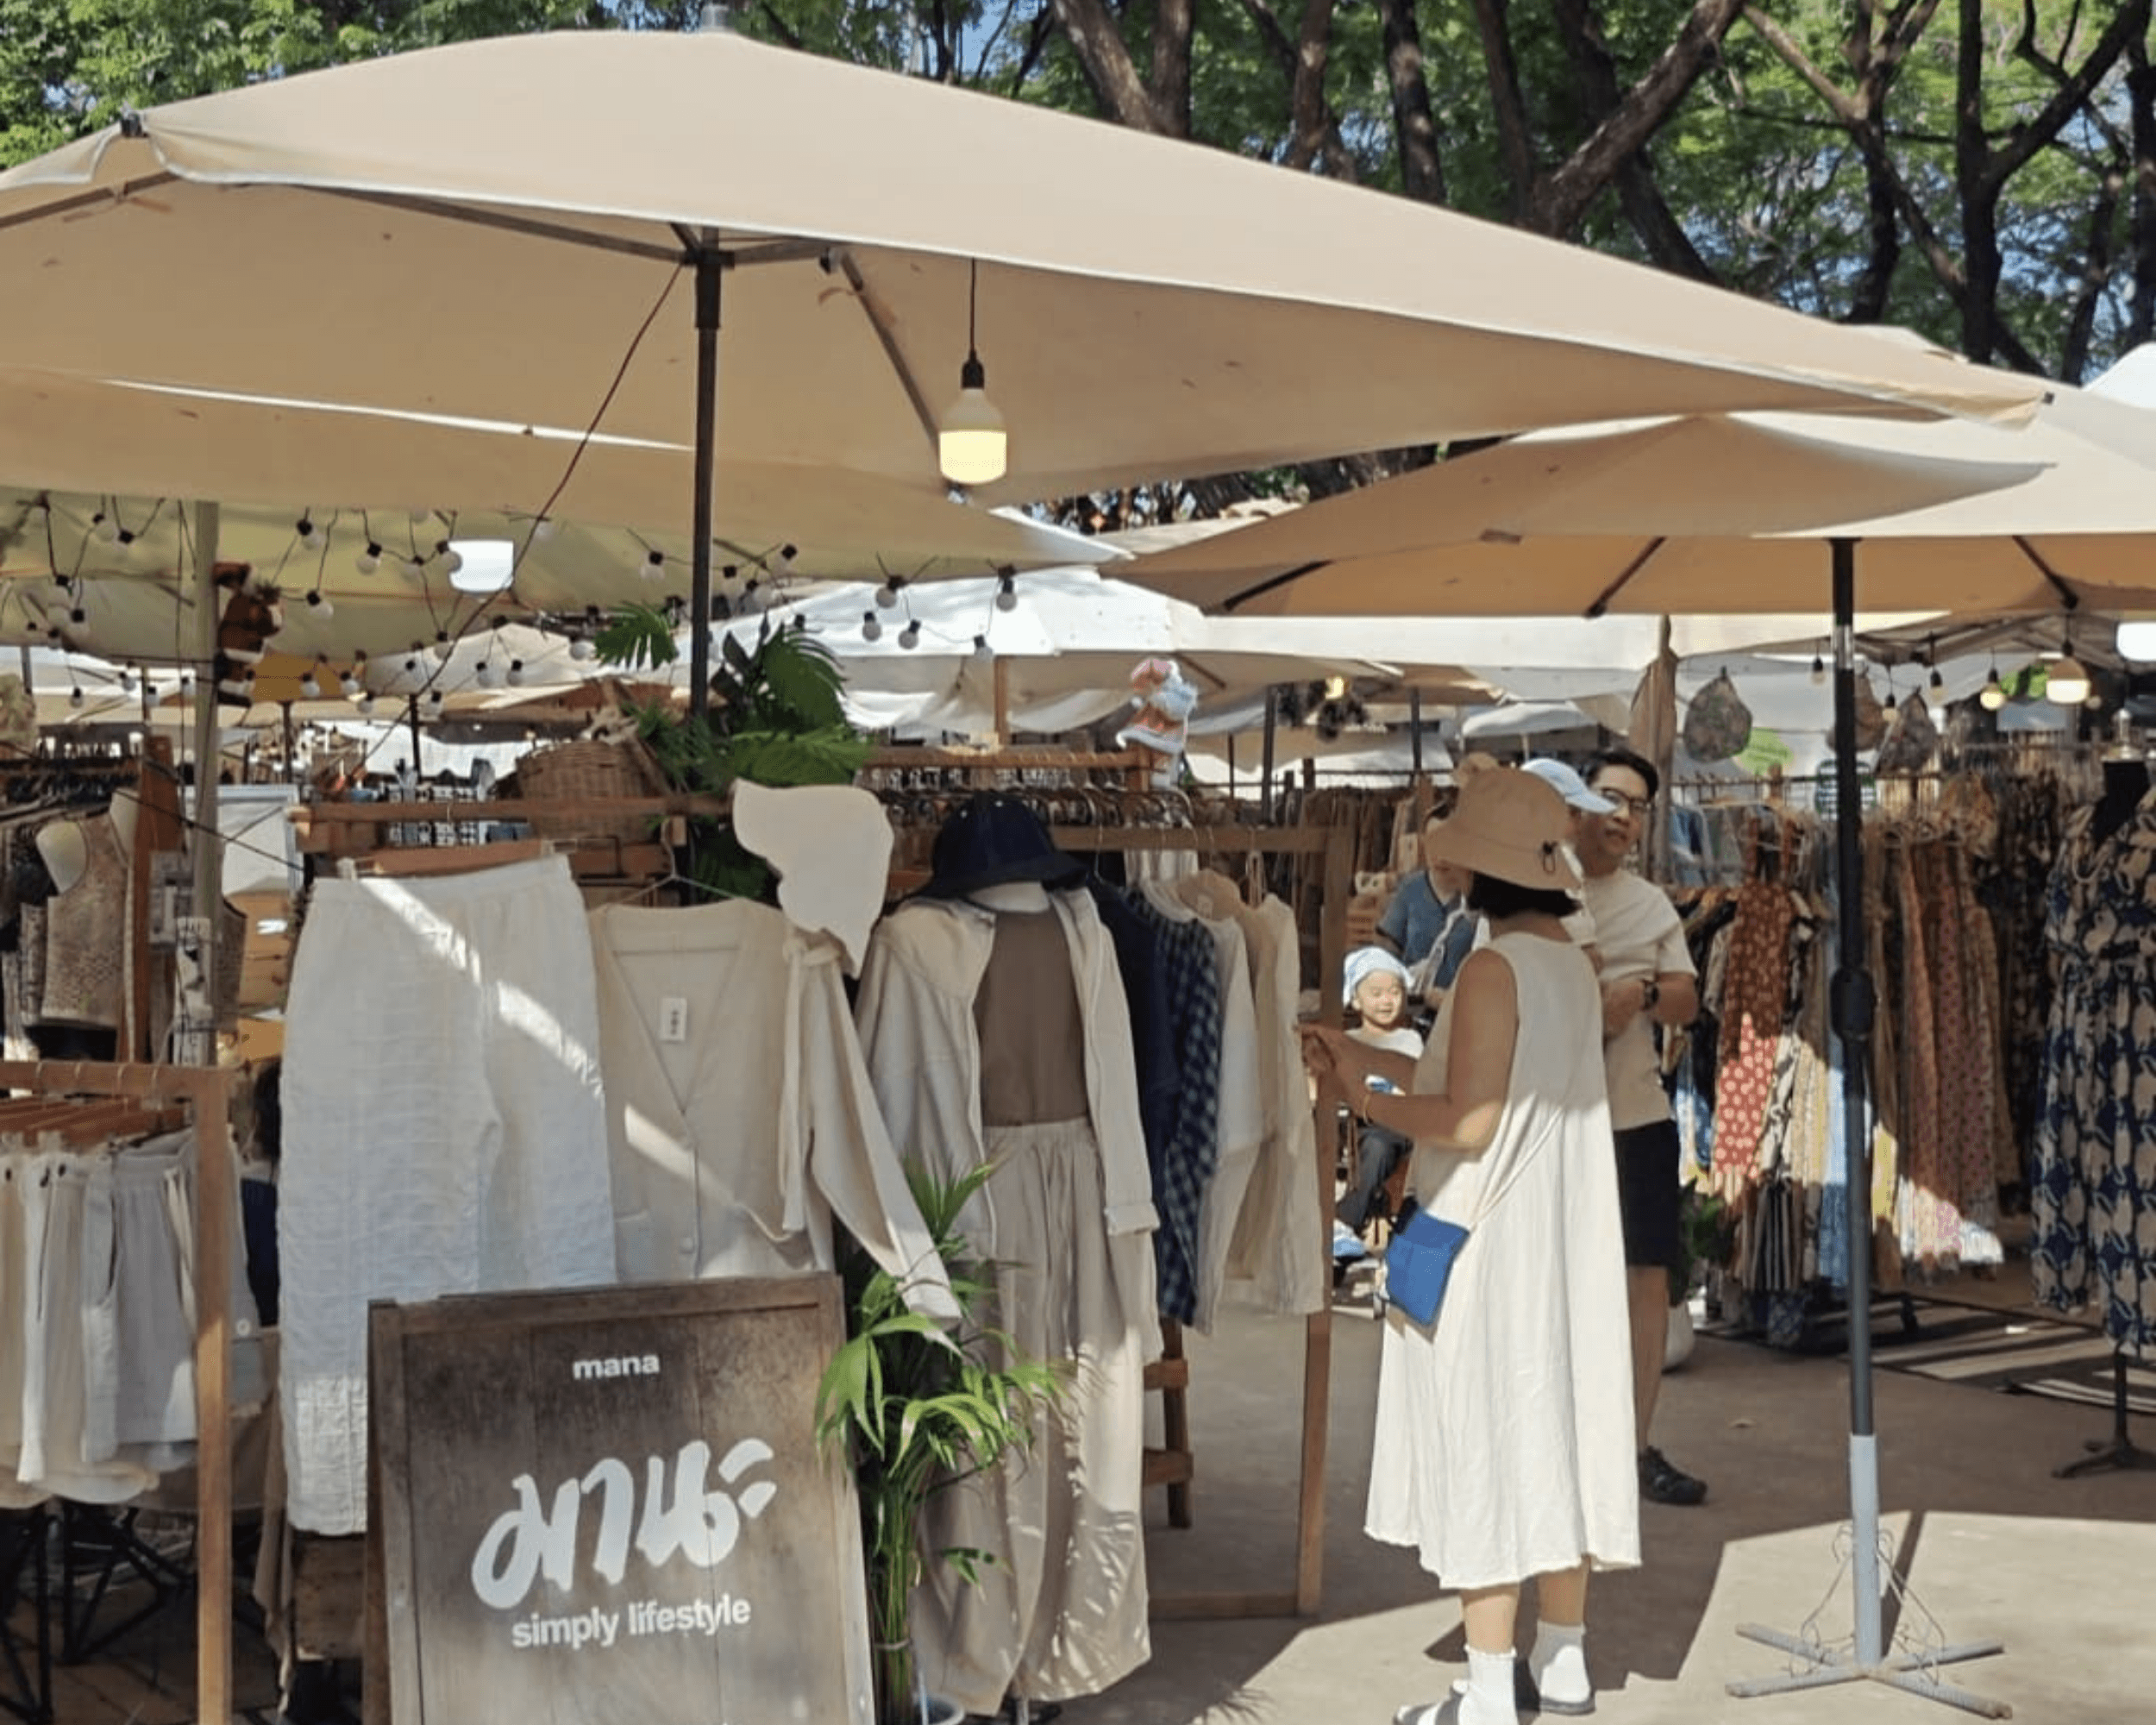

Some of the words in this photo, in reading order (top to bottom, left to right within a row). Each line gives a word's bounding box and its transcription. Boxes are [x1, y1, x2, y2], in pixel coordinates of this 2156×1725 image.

[573, 1355, 661, 1379] mana
[472, 1438, 777, 1610] มานะ
[512, 1606, 620, 1650] simply
[628, 1593, 752, 1636] lifestyle
